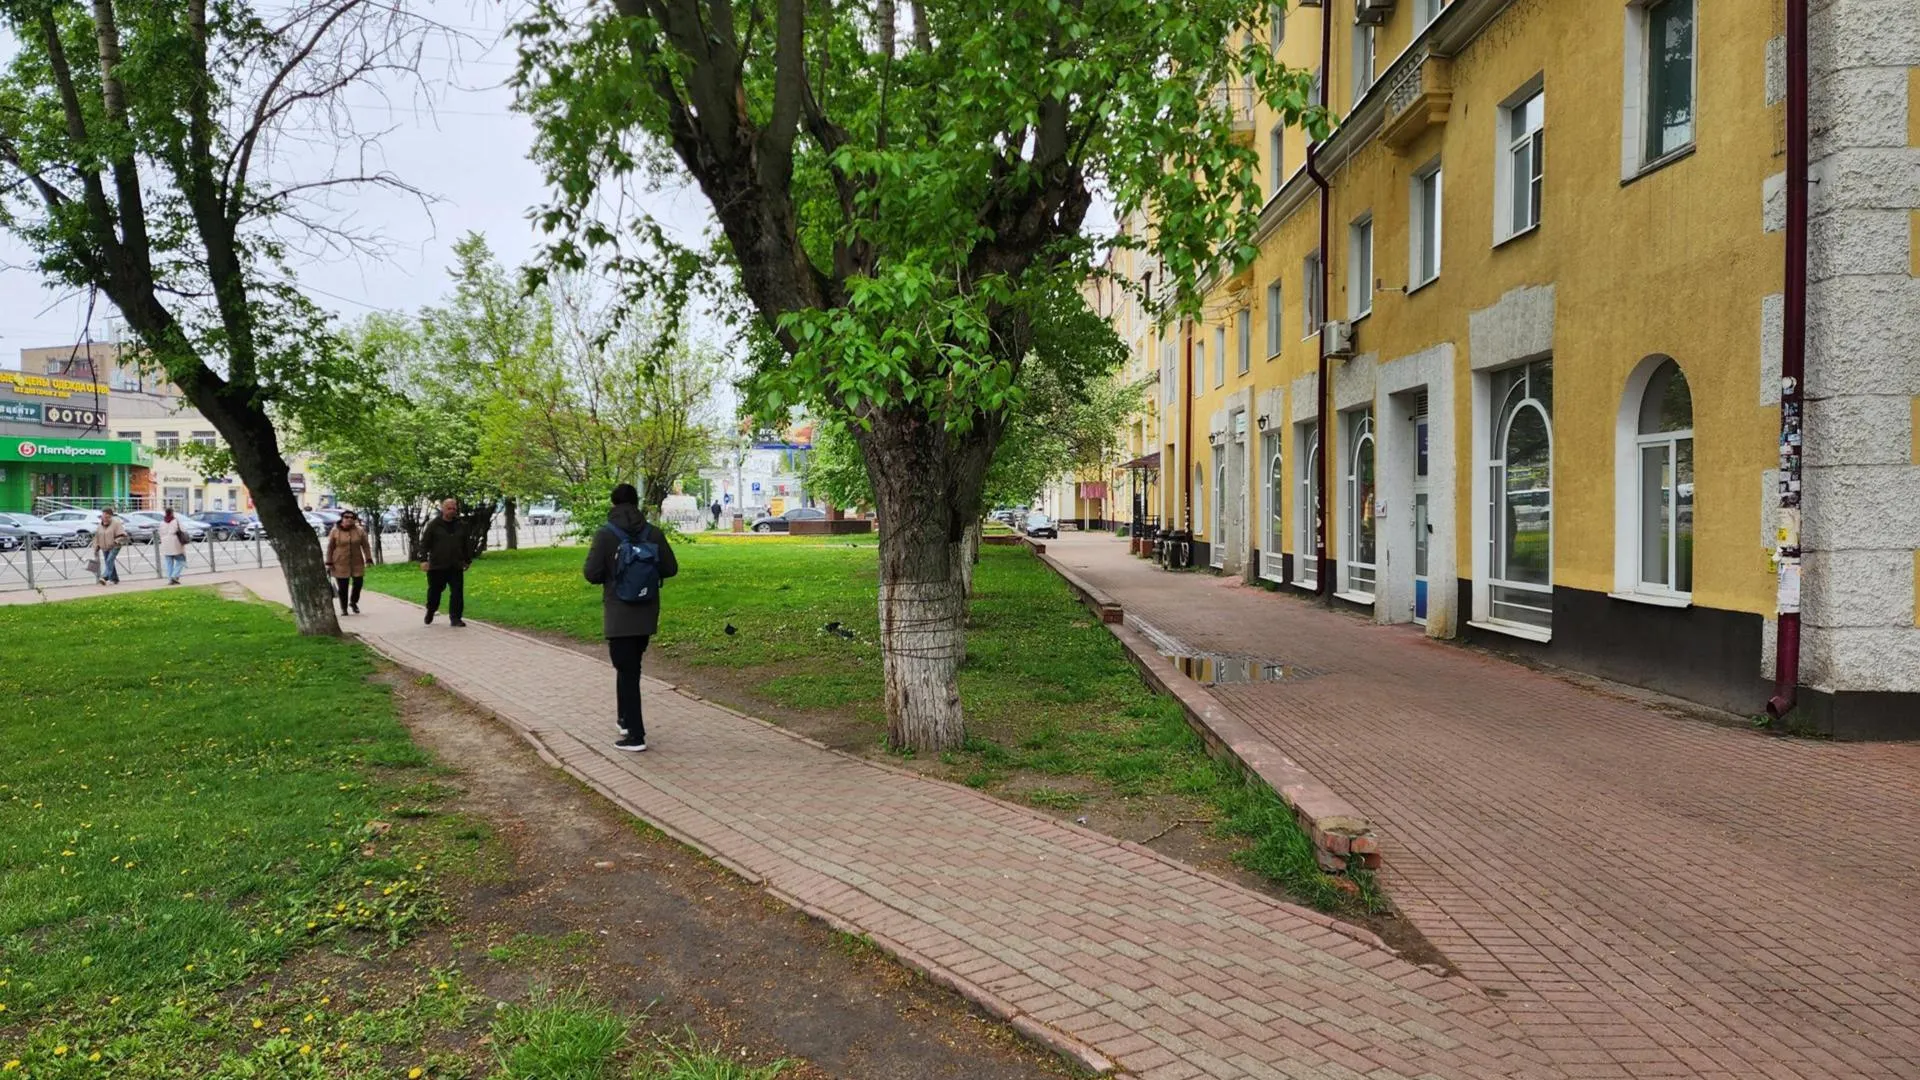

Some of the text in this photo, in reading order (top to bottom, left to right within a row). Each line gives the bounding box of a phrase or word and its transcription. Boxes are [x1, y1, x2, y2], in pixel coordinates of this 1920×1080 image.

[52, 379, 86, 392] ОДЕЖДА
[48, 407, 94, 424] ФОТО
[38, 444, 106, 457] Пятёрочка
